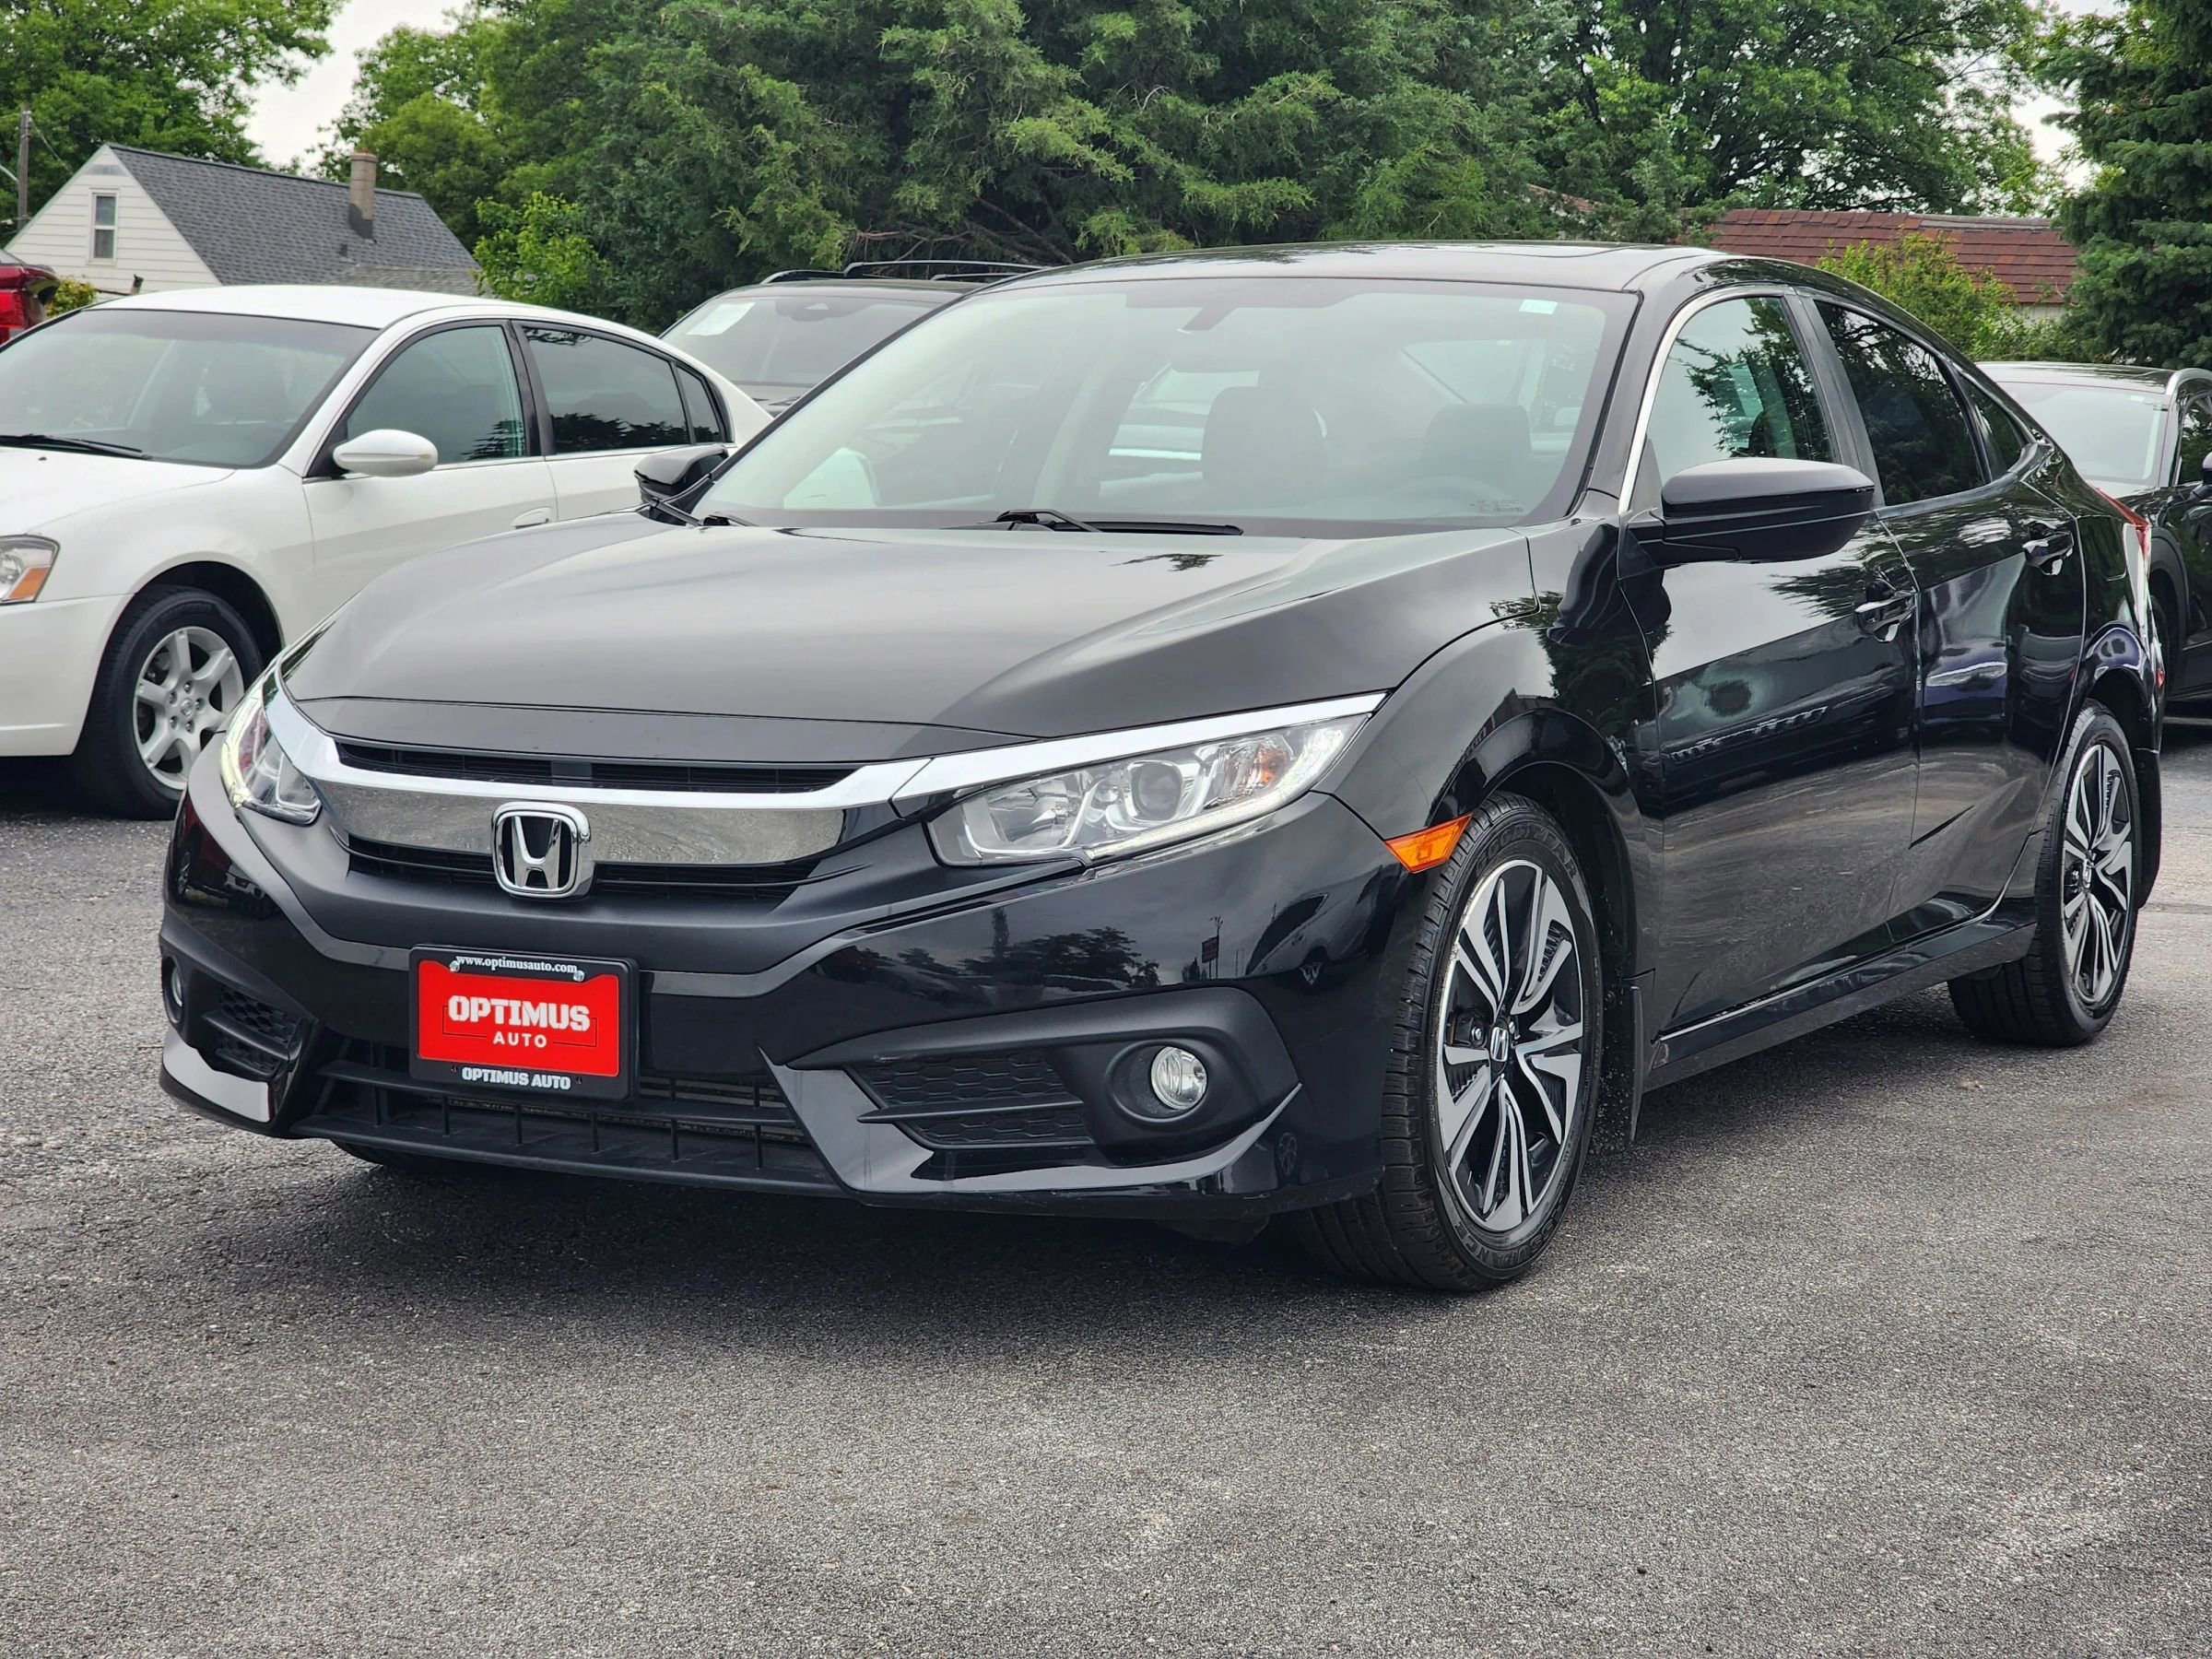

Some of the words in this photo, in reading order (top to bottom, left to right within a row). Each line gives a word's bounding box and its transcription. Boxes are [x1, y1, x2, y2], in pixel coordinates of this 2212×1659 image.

[455, 956, 578, 973] www.optimusauto.com
[448, 994, 591, 1032] OPTIMUS
[493, 1030, 547, 1048] AUTO
[462, 1066, 530, 1086] OPTIMUS
[531, 1073, 571, 1090] AUTO
